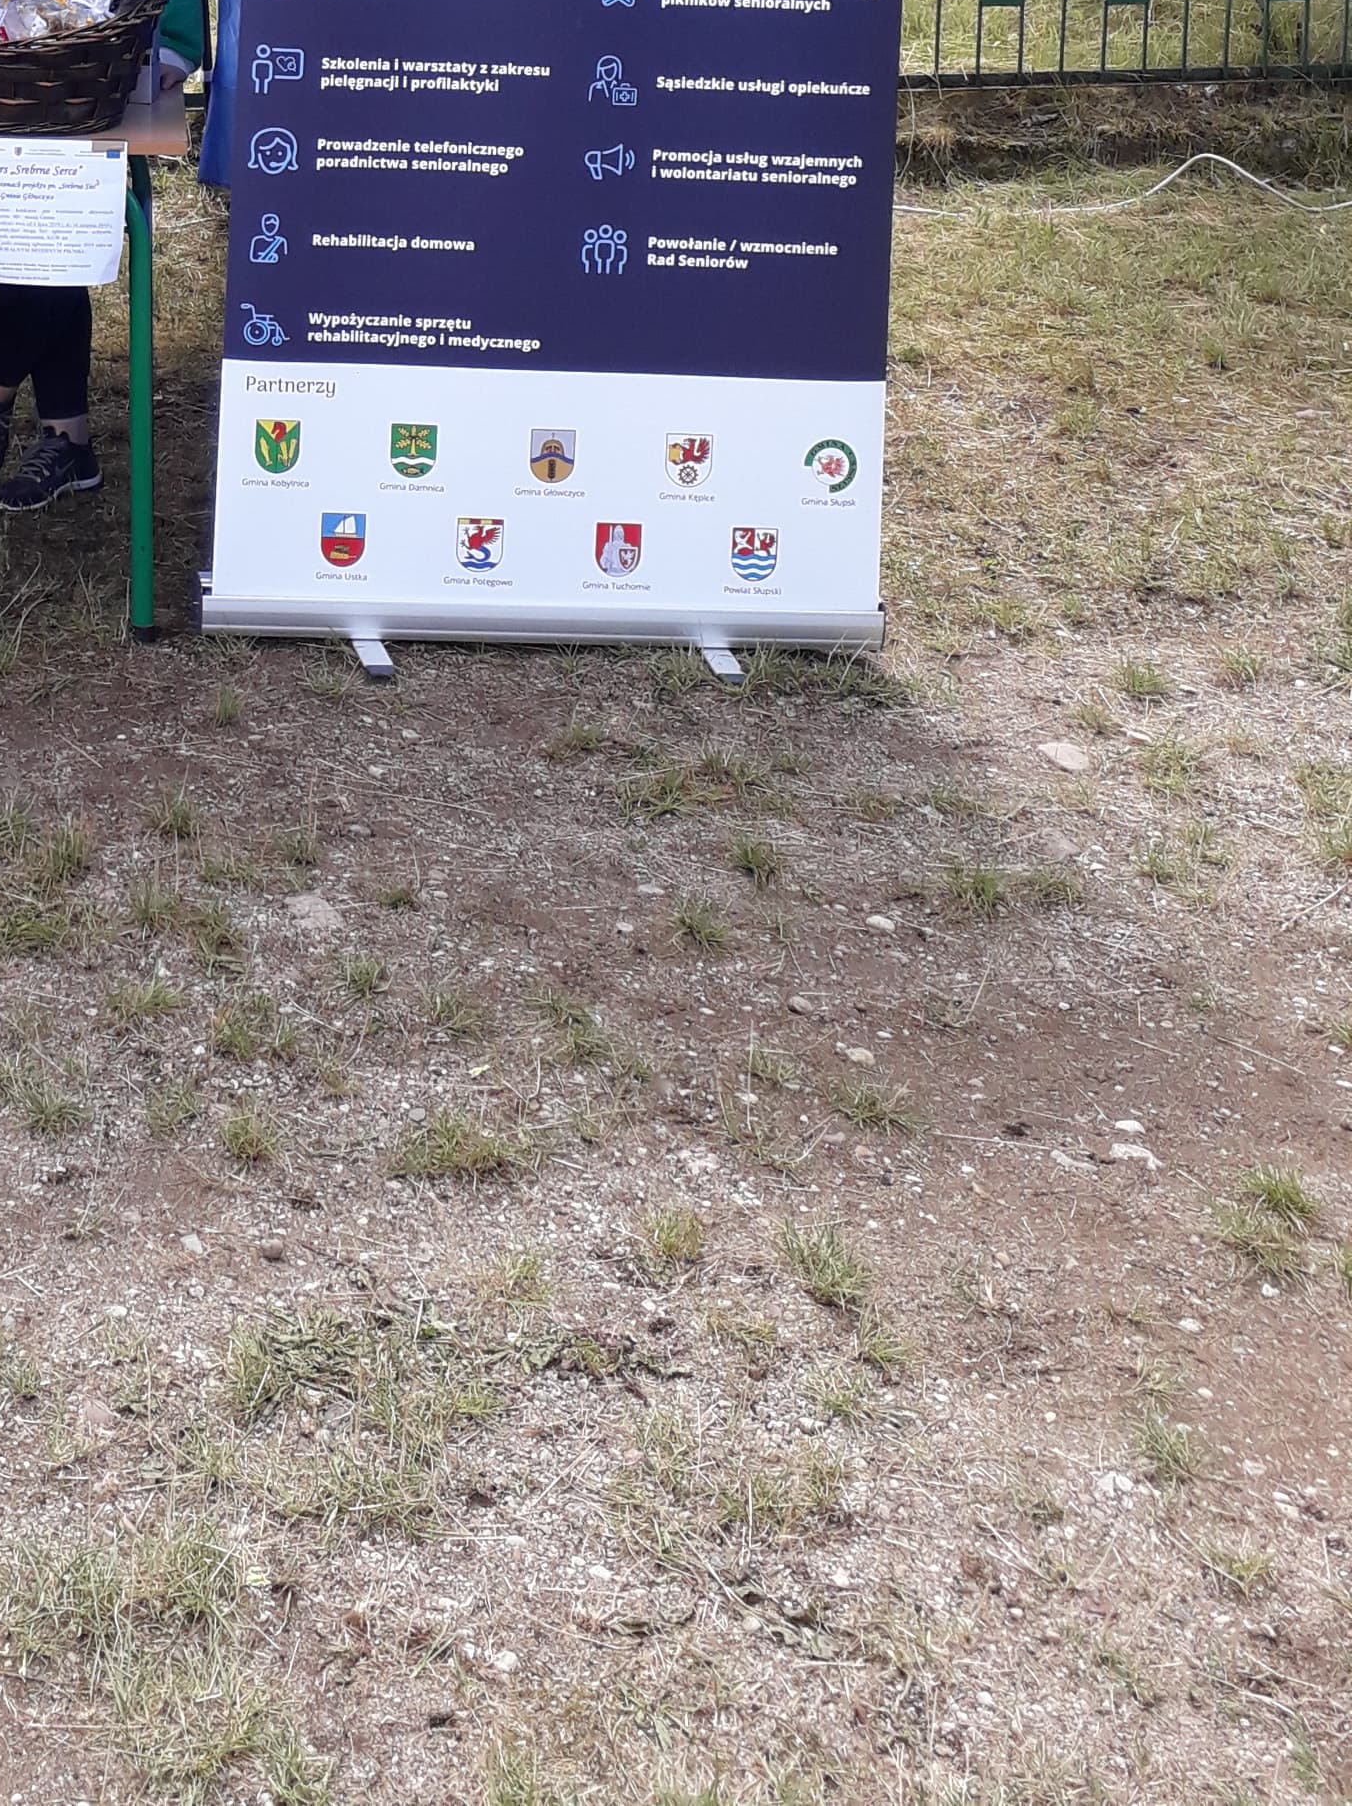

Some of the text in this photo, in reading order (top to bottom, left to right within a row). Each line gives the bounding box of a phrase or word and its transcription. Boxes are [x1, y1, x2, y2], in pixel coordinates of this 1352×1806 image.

[321, 57, 550, 77] Szkolenia i warsztaty z zakresu
[320, 73, 499, 94] pielęgnacji i profilaktyki
[656, 75, 870, 97] Sąsiedzkie usługi opiekuńcze
[317, 138, 524, 159] Prowadzenie telefonicznego
[316, 155, 508, 176] poradnictwa senioralnego
[652, 148, 862, 171] Promocja usług wzajemnych
[651, 165, 856, 188] i wolontariatu senioralnego
[312, 233, 475, 251] Rehabilitacja domowa
[648, 236, 838, 255] Powołanie / wzmocnienie
[647, 253, 749, 269] Rad Seniorów
[308, 312, 471, 332] Wypożyczanie sprzętu
[307, 329, 540, 352] rehabilitacyjnego i medycznego
[246, 375, 336, 398] Partnerzy
[241, 478, 268, 486] Gmina
[379, 482, 445, 492] Gmina Damnica
[514, 487, 541, 496] Gmina
[658, 491, 686, 501] Gmina
[801, 497, 828, 506] Gmina
[315, 571, 367, 581] Gmina Ustka
[443, 576, 470, 585] Gmina
[582, 580, 651, 591] Gmina Tuchomie
